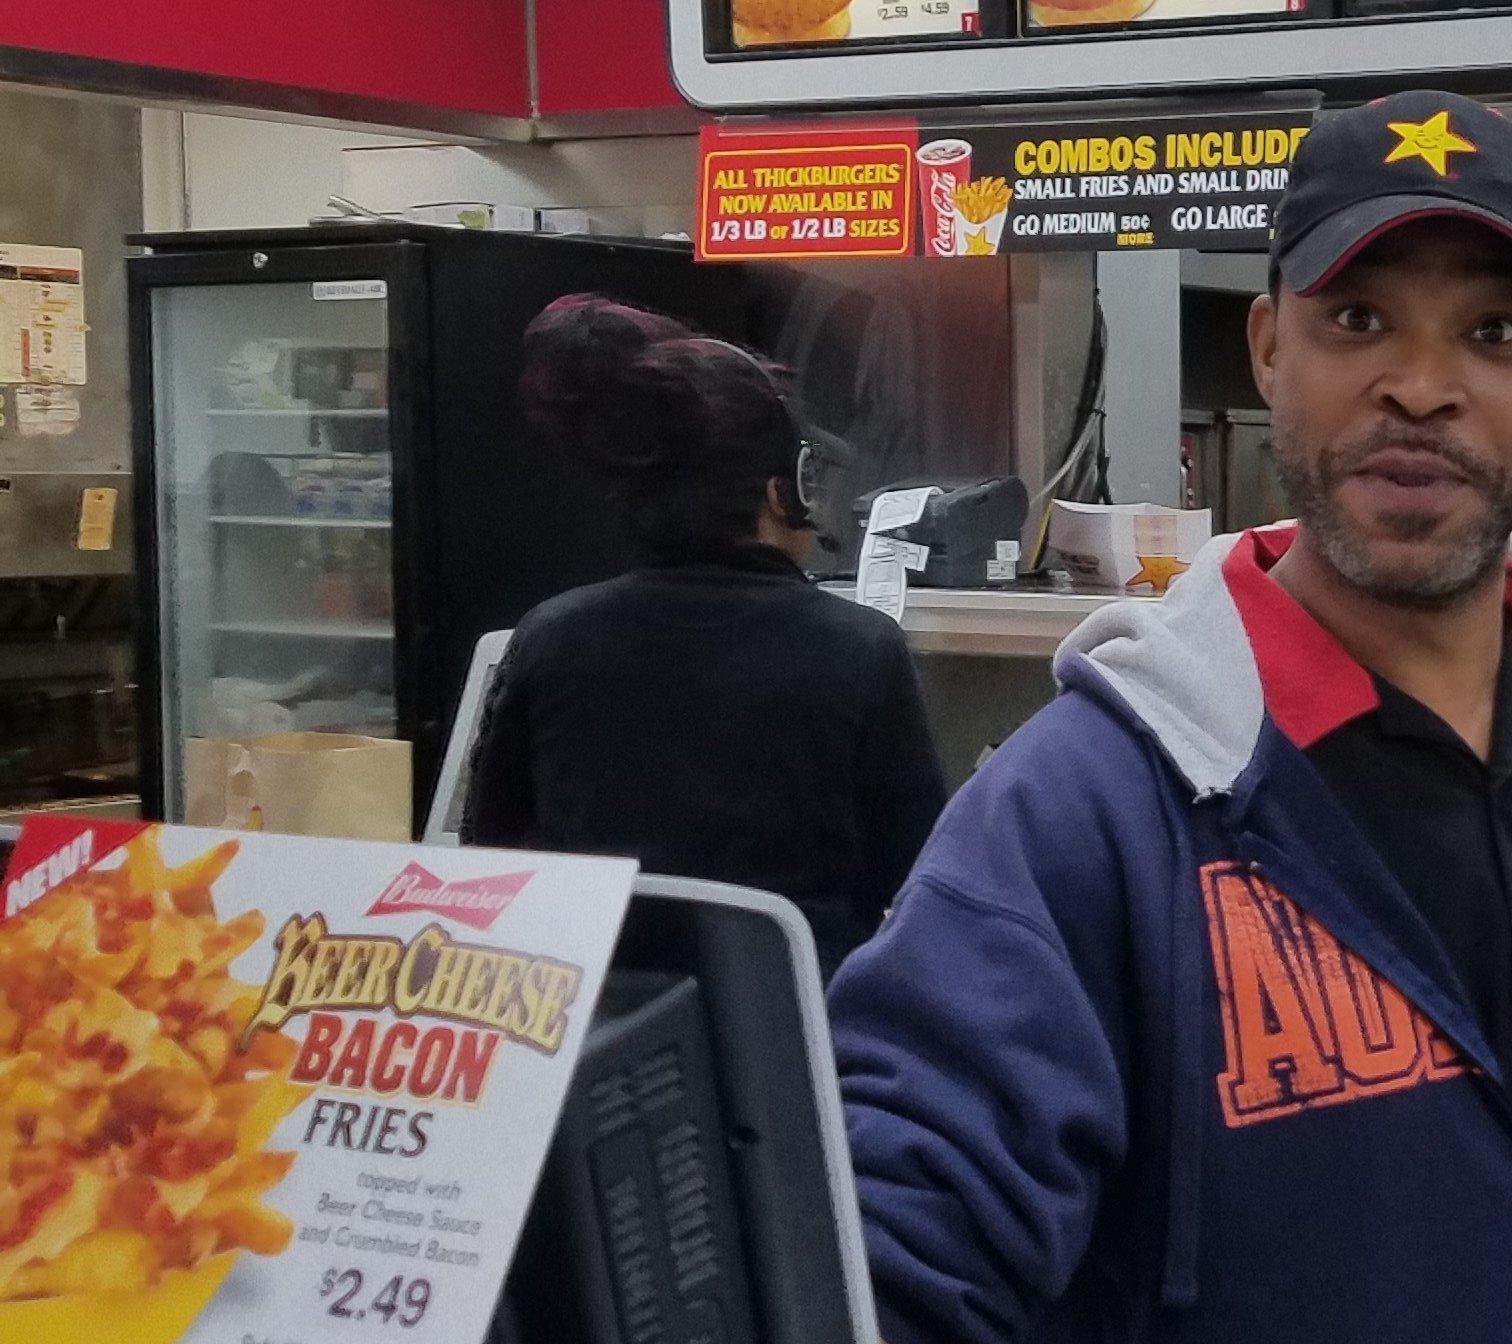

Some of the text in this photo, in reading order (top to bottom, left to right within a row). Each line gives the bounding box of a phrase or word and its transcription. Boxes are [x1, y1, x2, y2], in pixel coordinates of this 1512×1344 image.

[1014, 135, 1157, 175] COMBOS
[713, 164, 900, 190] ALL THICKBURGERS
[1014, 170, 1242, 200] SMALL FRIES AND SMALL
[719, 190, 892, 215] NOW AVAILABLE IN
[1012, 204, 1269, 236] GO MEDIUM 50¢ GO LARGE
[711, 218, 900, 242] 1/3 LB or 1/2 LB SIZES
[6, 829, 93, 918] NEW!
[247, 910, 583, 1058] BEER CHEESE
[289, 1009, 504, 1108] BACON
[303, 1097, 434, 1158] FRIES
[321, 1268, 431, 1328] $2.49
